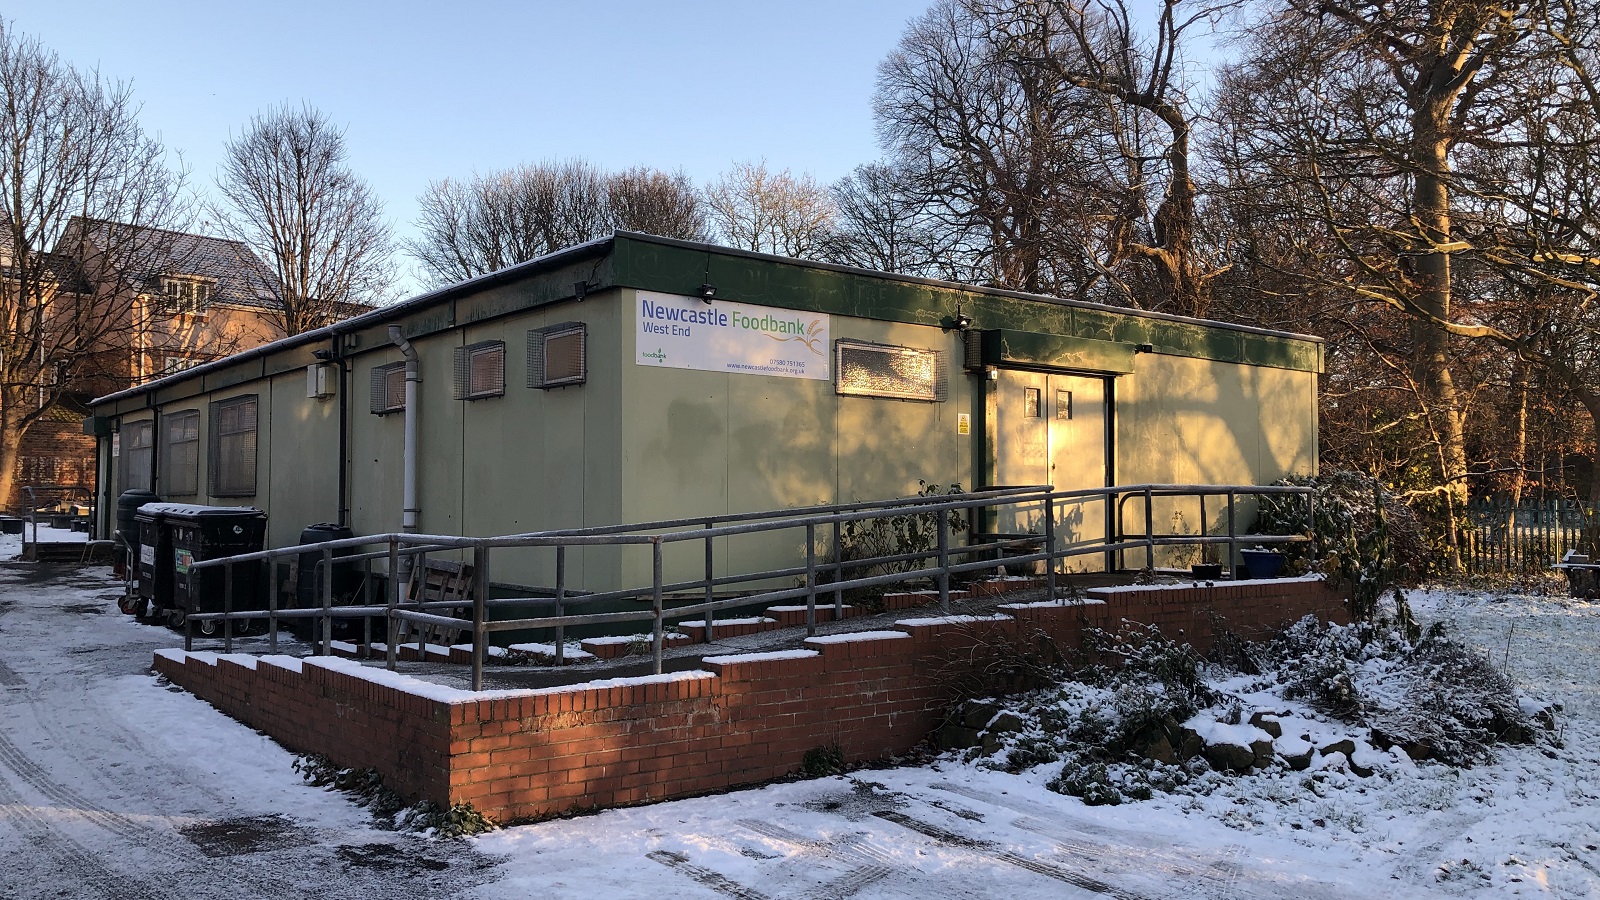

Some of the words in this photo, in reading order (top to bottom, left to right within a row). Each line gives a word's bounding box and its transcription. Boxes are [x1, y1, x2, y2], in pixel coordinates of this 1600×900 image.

[642, 299, 728, 327] Newcastle
[732, 310, 805, 336] Foodbank
[643, 321, 670, 335] West
[672, 324, 691, 337] End
[727, 363, 805, 375] www.newcastlefoodbank.org.uk
